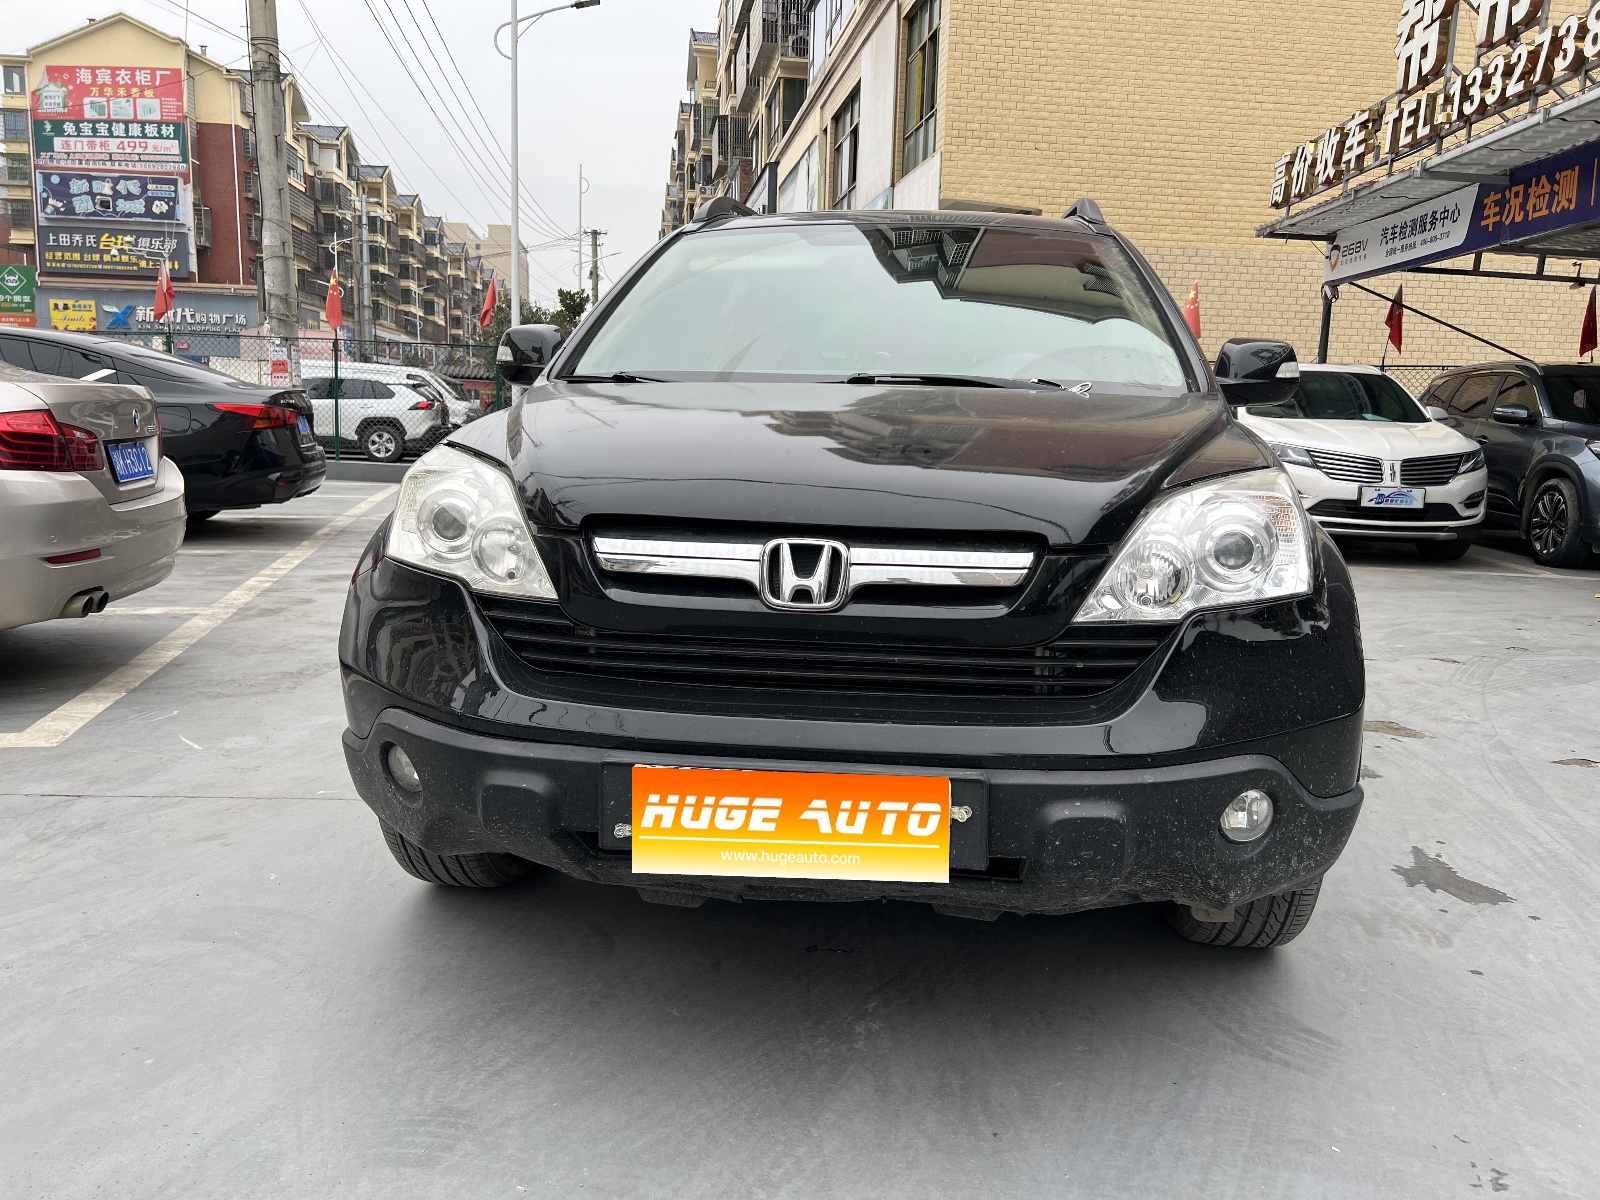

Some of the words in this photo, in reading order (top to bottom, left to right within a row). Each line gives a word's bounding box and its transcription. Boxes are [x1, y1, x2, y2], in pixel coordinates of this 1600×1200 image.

[75, 67, 172, 86] 海宾衣柜厂
[62, 121, 176, 138] 兔宝宝健康板材
[60, 139, 111, 151] 连门带柜
[116, 140, 149, 152] 499
[1269, 110, 1370, 208] 高价收车
[1480, 165, 1580, 232] 车况检测
[1379, 203, 1461, 246] 汽车检测服务中心
[187, 325, 221, 333] SHOPPING
